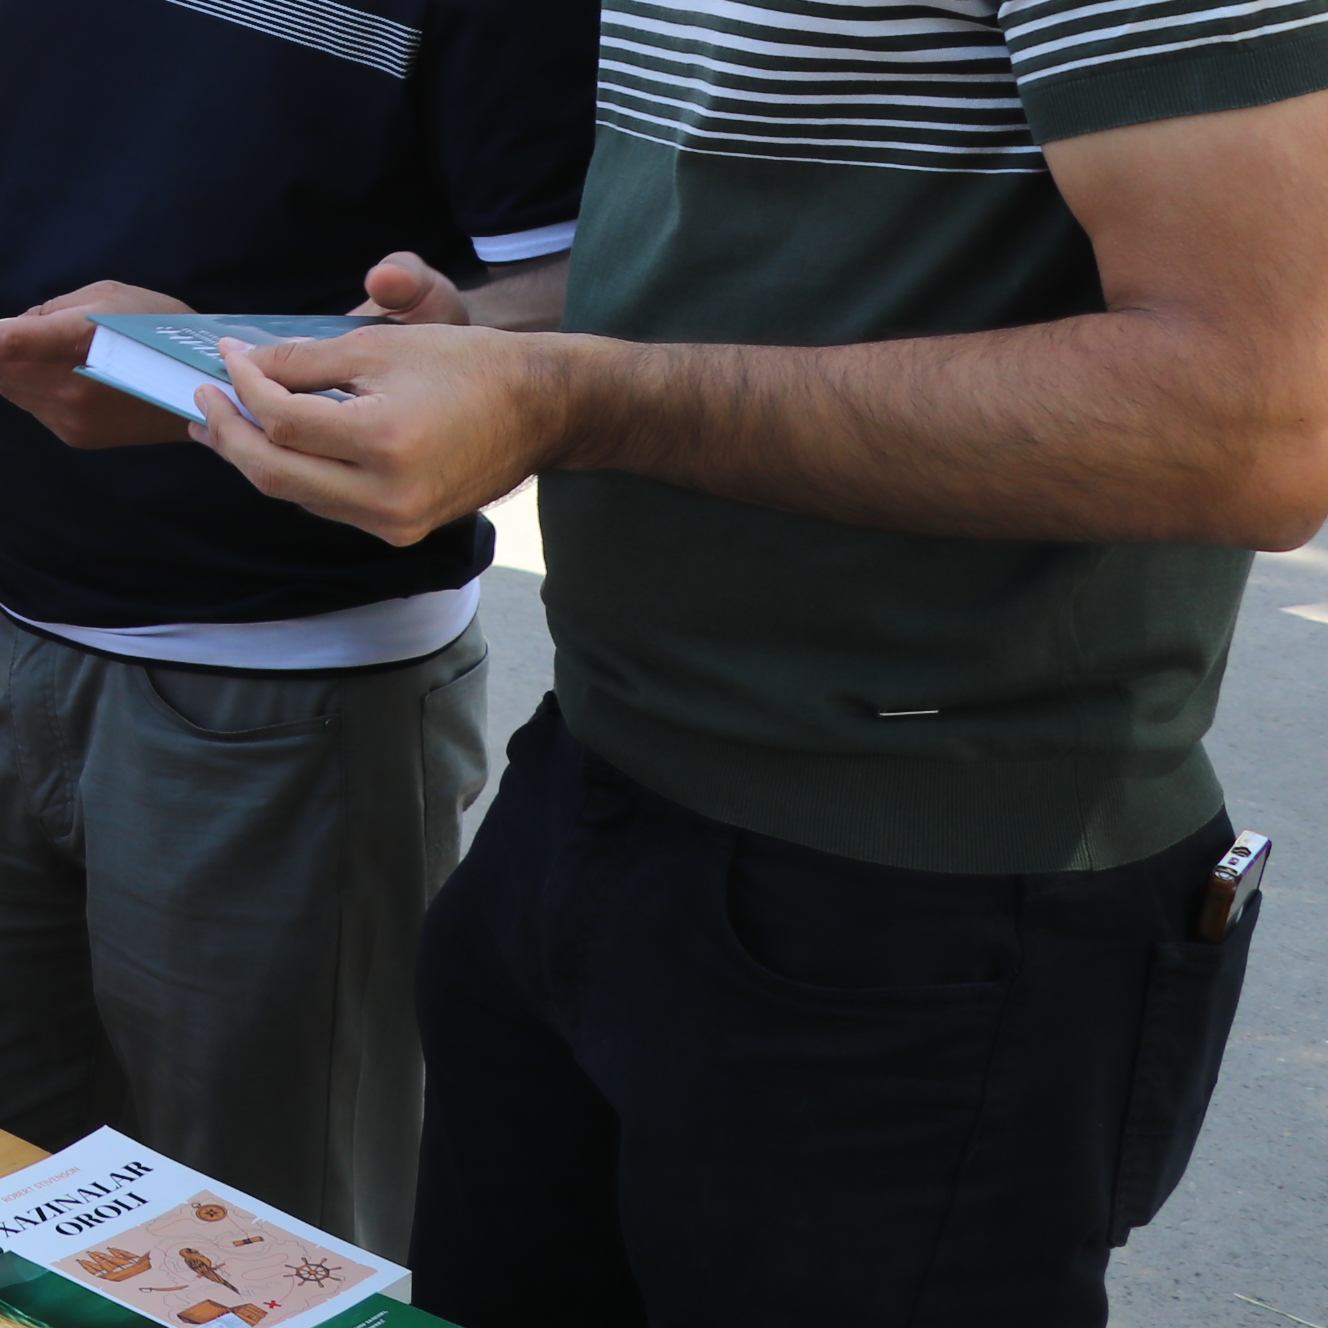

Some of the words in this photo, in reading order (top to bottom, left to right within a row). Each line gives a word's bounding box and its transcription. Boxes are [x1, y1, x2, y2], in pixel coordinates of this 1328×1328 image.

[0, 1184, 38, 1204] ROBERT
[40, 1166, 82, 1188] STIVENSON
[55, 1193, 152, 1240] OROLI
